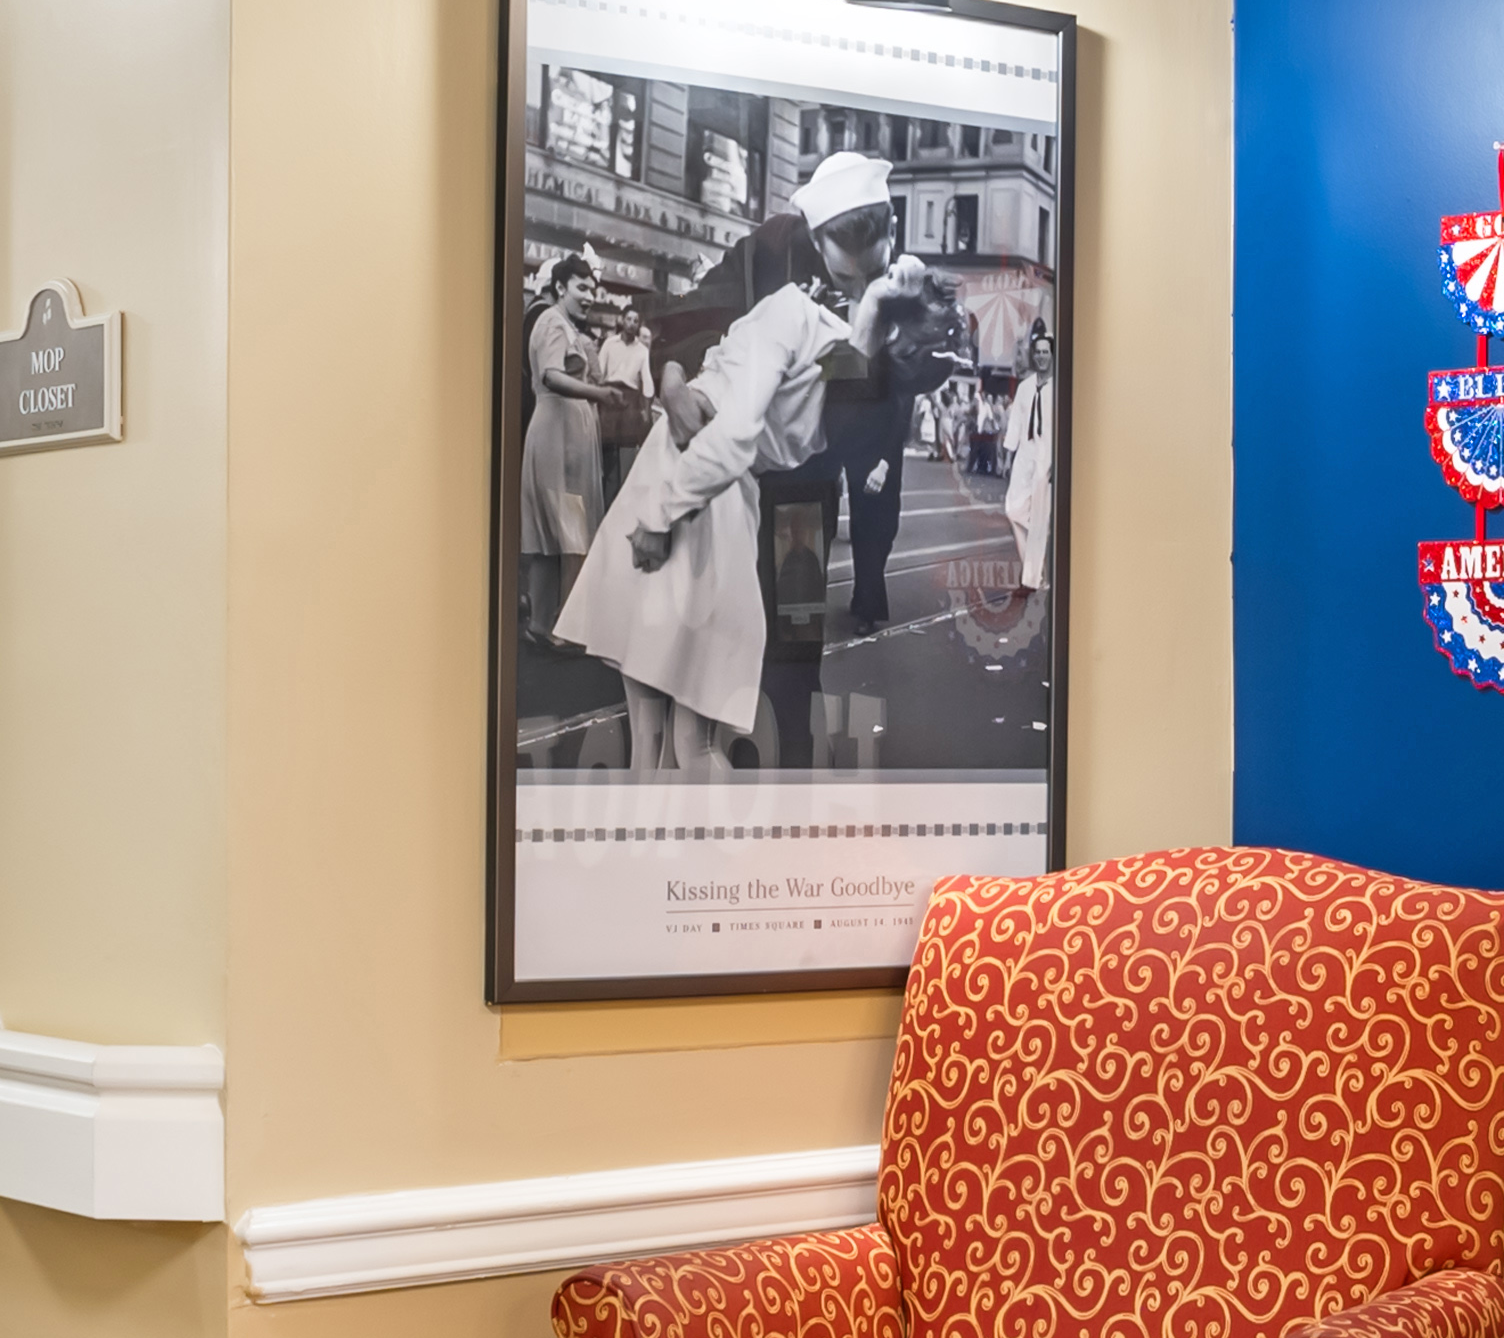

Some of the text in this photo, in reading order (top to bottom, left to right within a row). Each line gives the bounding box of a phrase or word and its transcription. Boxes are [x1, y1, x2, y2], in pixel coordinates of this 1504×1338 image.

[30, 347, 65, 375] MOP
[19, 383, 77, 415] CLOSET
[666, 875, 916, 905] Kissing the War Goodbye
[665, 924, 678, 933] VJ
[682, 924, 703, 933] DAY
[729, 922, 761, 931] TIMES
[764, 920, 805, 932] SQUARE
[830, 918, 869, 928] AUGUST
